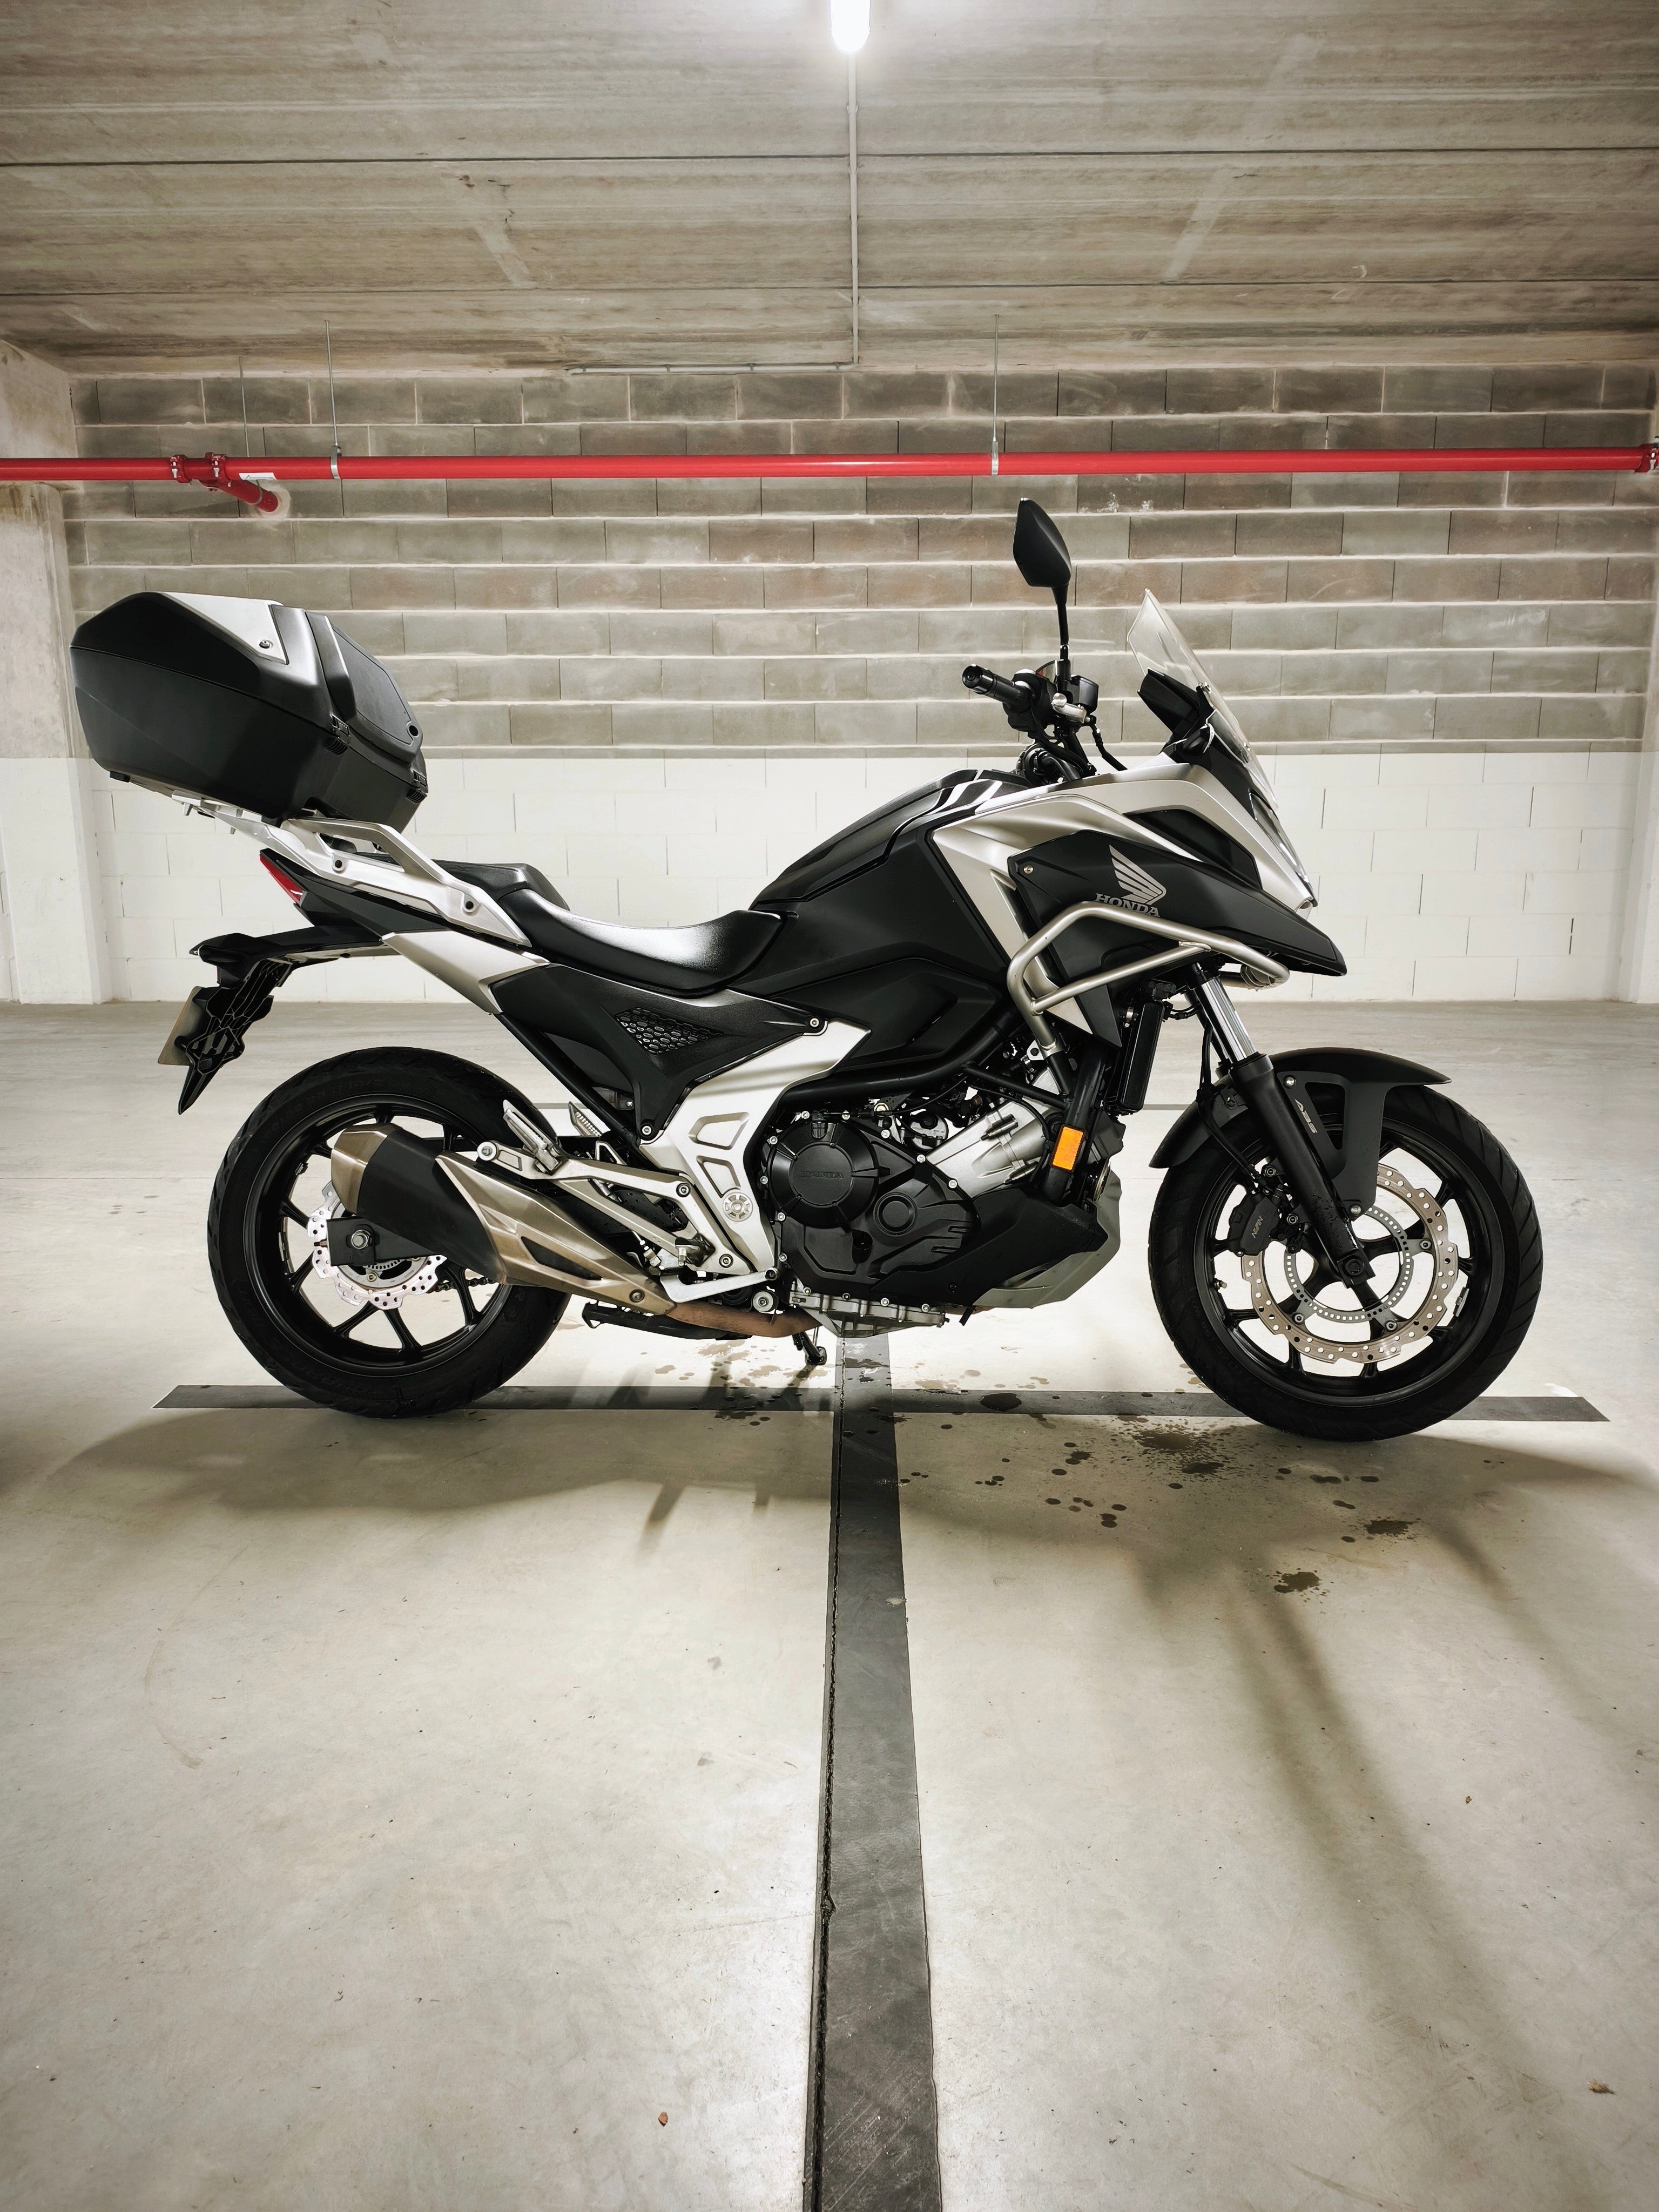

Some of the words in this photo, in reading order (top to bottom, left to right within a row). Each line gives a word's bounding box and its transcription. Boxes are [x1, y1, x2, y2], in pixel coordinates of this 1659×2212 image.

[1095, 893, 1161, 918] HONDA
[1294, 1099, 1318, 1133] ABS
[799, 1170, 844, 1179] HONDA
